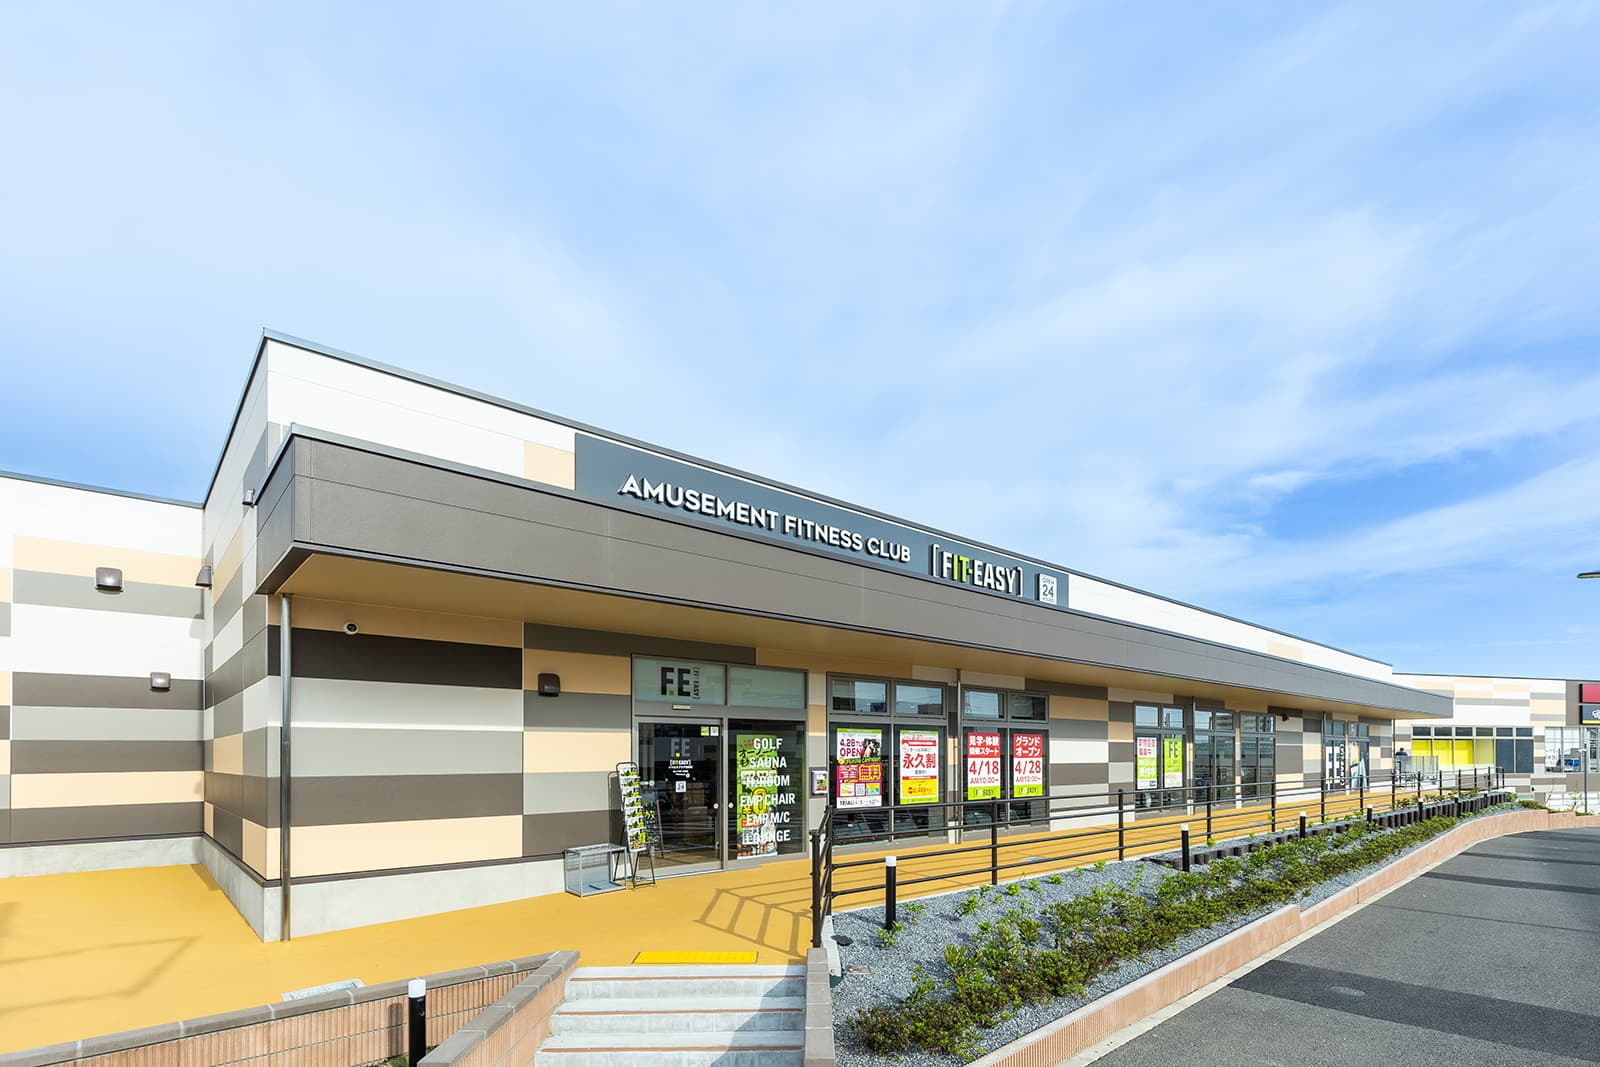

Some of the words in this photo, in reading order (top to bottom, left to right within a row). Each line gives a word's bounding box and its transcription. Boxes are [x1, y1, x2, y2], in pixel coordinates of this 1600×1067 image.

[619, 474, 779, 529] AMUSEMENT
[784, 514, 863, 551] FITNESS
[867, 537, 911, 562] CLUB
[1042, 585, 1054, 597] 24
[753, 738, 783, 750] GOLF
[839, 739, 856, 748] 4.28
[1015, 736, 1041, 747] グランド
[839, 748, 864, 757] OPEN
[1015, 747, 1041, 757] オープン
[750, 757, 788, 768] SAUNA
[903, 753, 936, 769] 永久割
[969, 760, 999, 776] 4/18
[1015, 760, 1041, 775] 4/28
[740, 794, 763, 807] EMP
[765, 793, 796, 805] CHAIR
[770, 811, 790, 824] M/C
